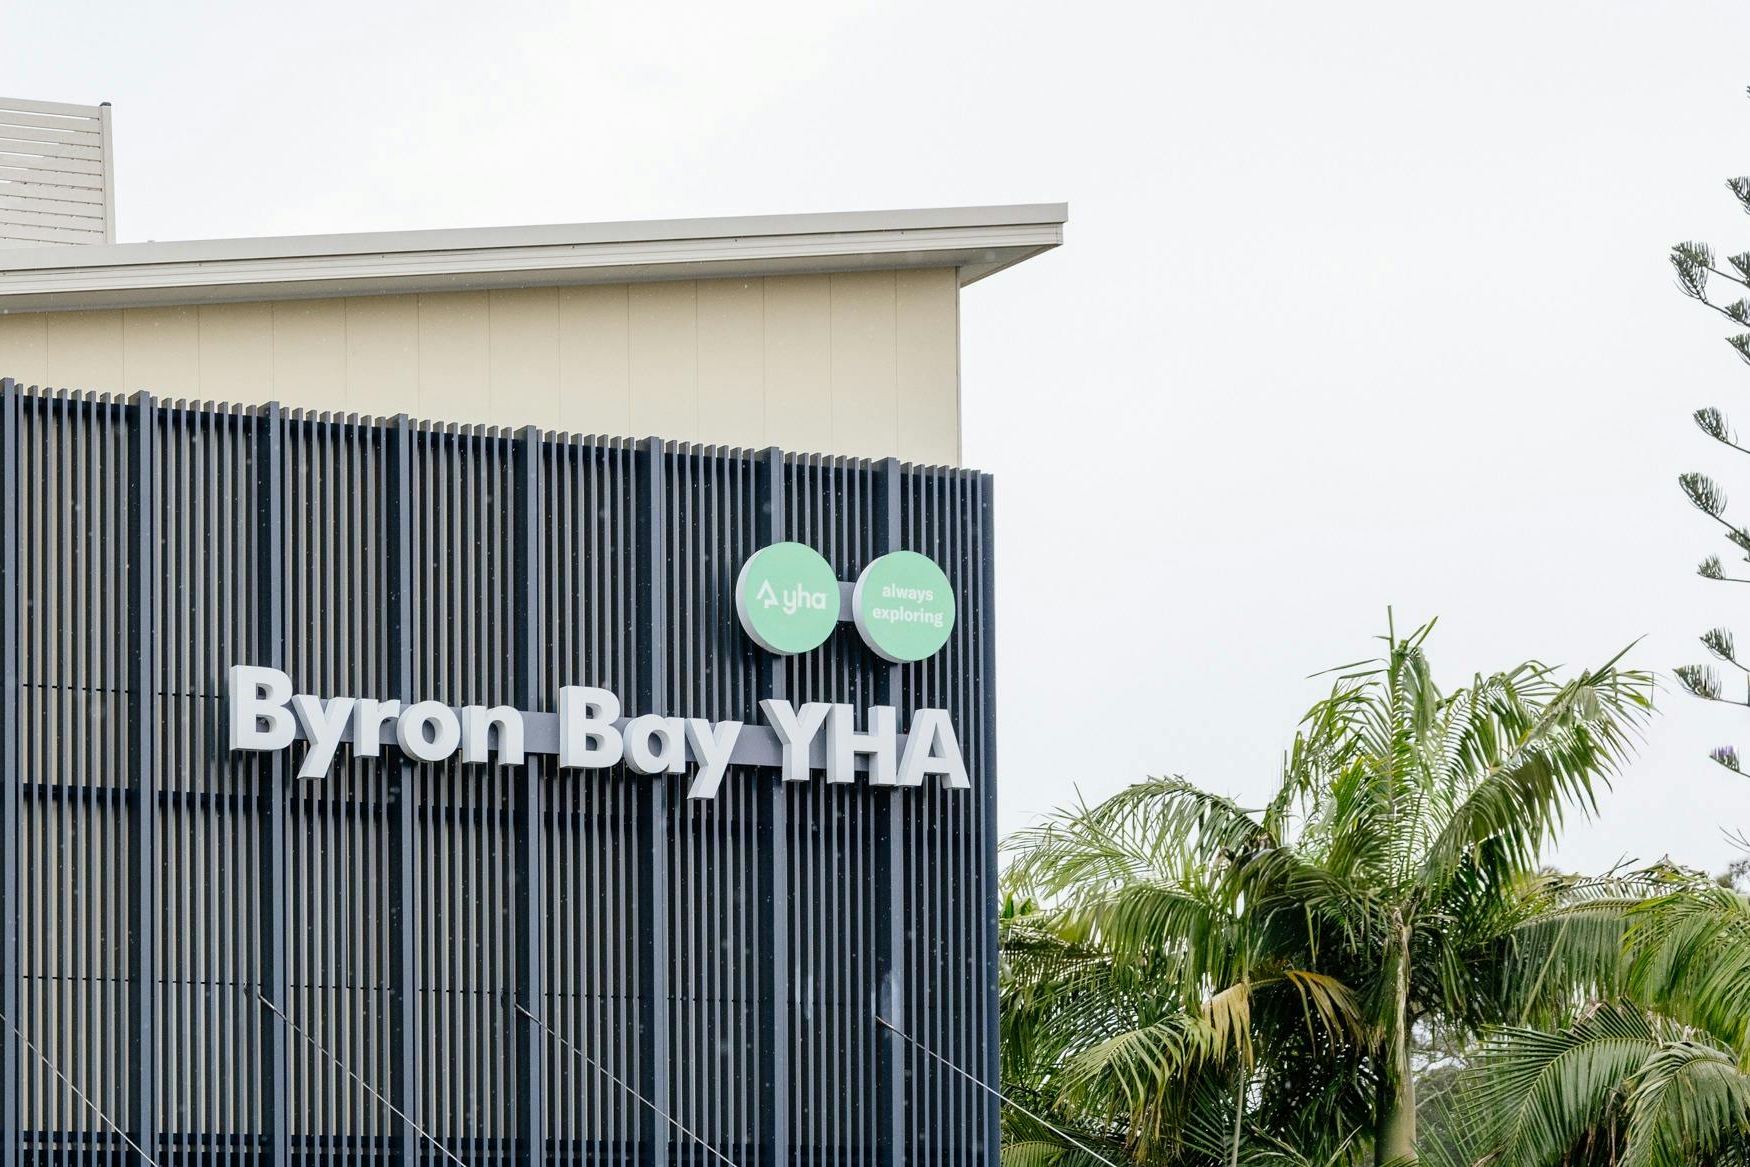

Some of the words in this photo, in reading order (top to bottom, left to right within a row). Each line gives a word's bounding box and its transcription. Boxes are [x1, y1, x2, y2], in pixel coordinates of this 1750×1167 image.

[782, 583, 827, 615] yha
[881, 583, 935, 604] always
[871, 605, 944, 628] exploring
[229, 664, 525, 780] Byron
[559, 685, 744, 799] Bay
[759, 698, 971, 789] YHA
